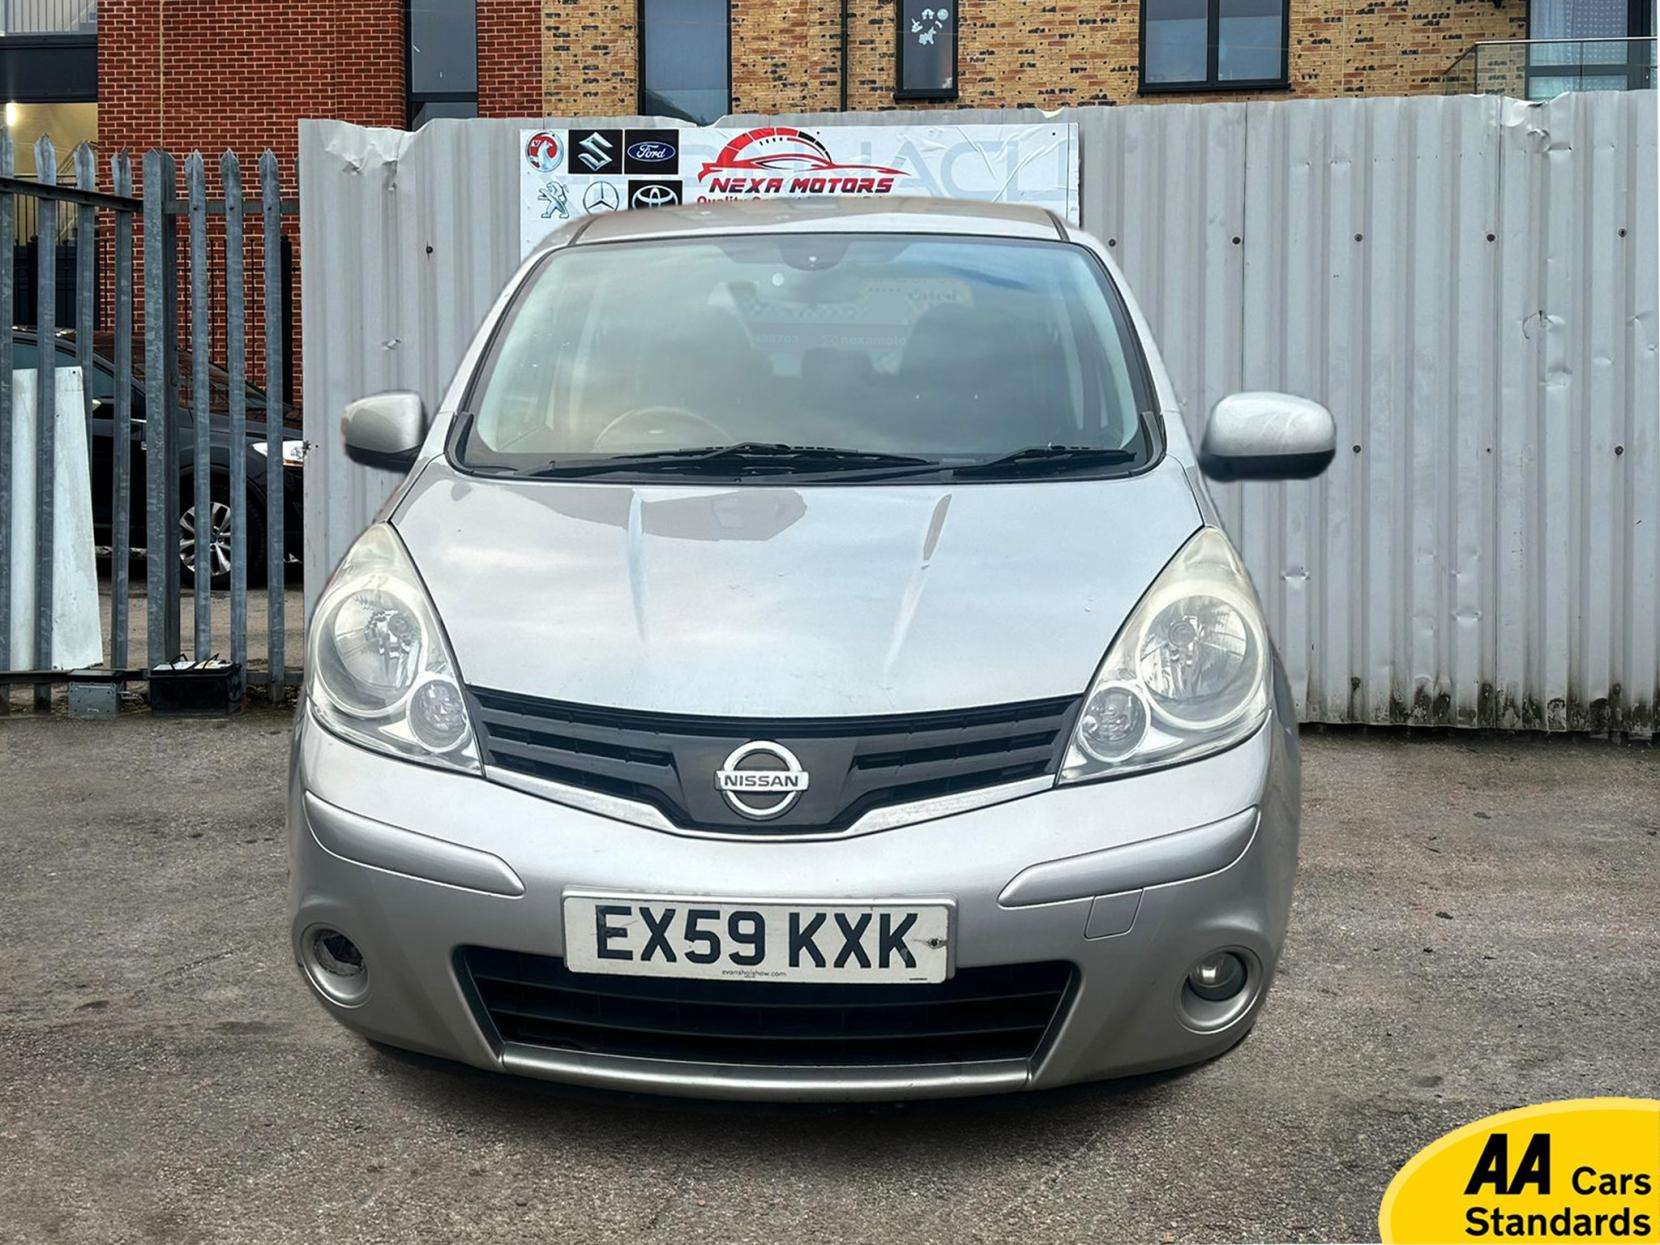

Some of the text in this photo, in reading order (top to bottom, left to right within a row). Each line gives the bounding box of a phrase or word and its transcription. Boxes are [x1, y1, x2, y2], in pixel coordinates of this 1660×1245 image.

[636, 145, 667, 159] Ford
[709, 177, 895, 194] NEXA MOTORS
[724, 775, 799, 787] NISSAN
[595, 904, 919, 969] EX59 KXK
